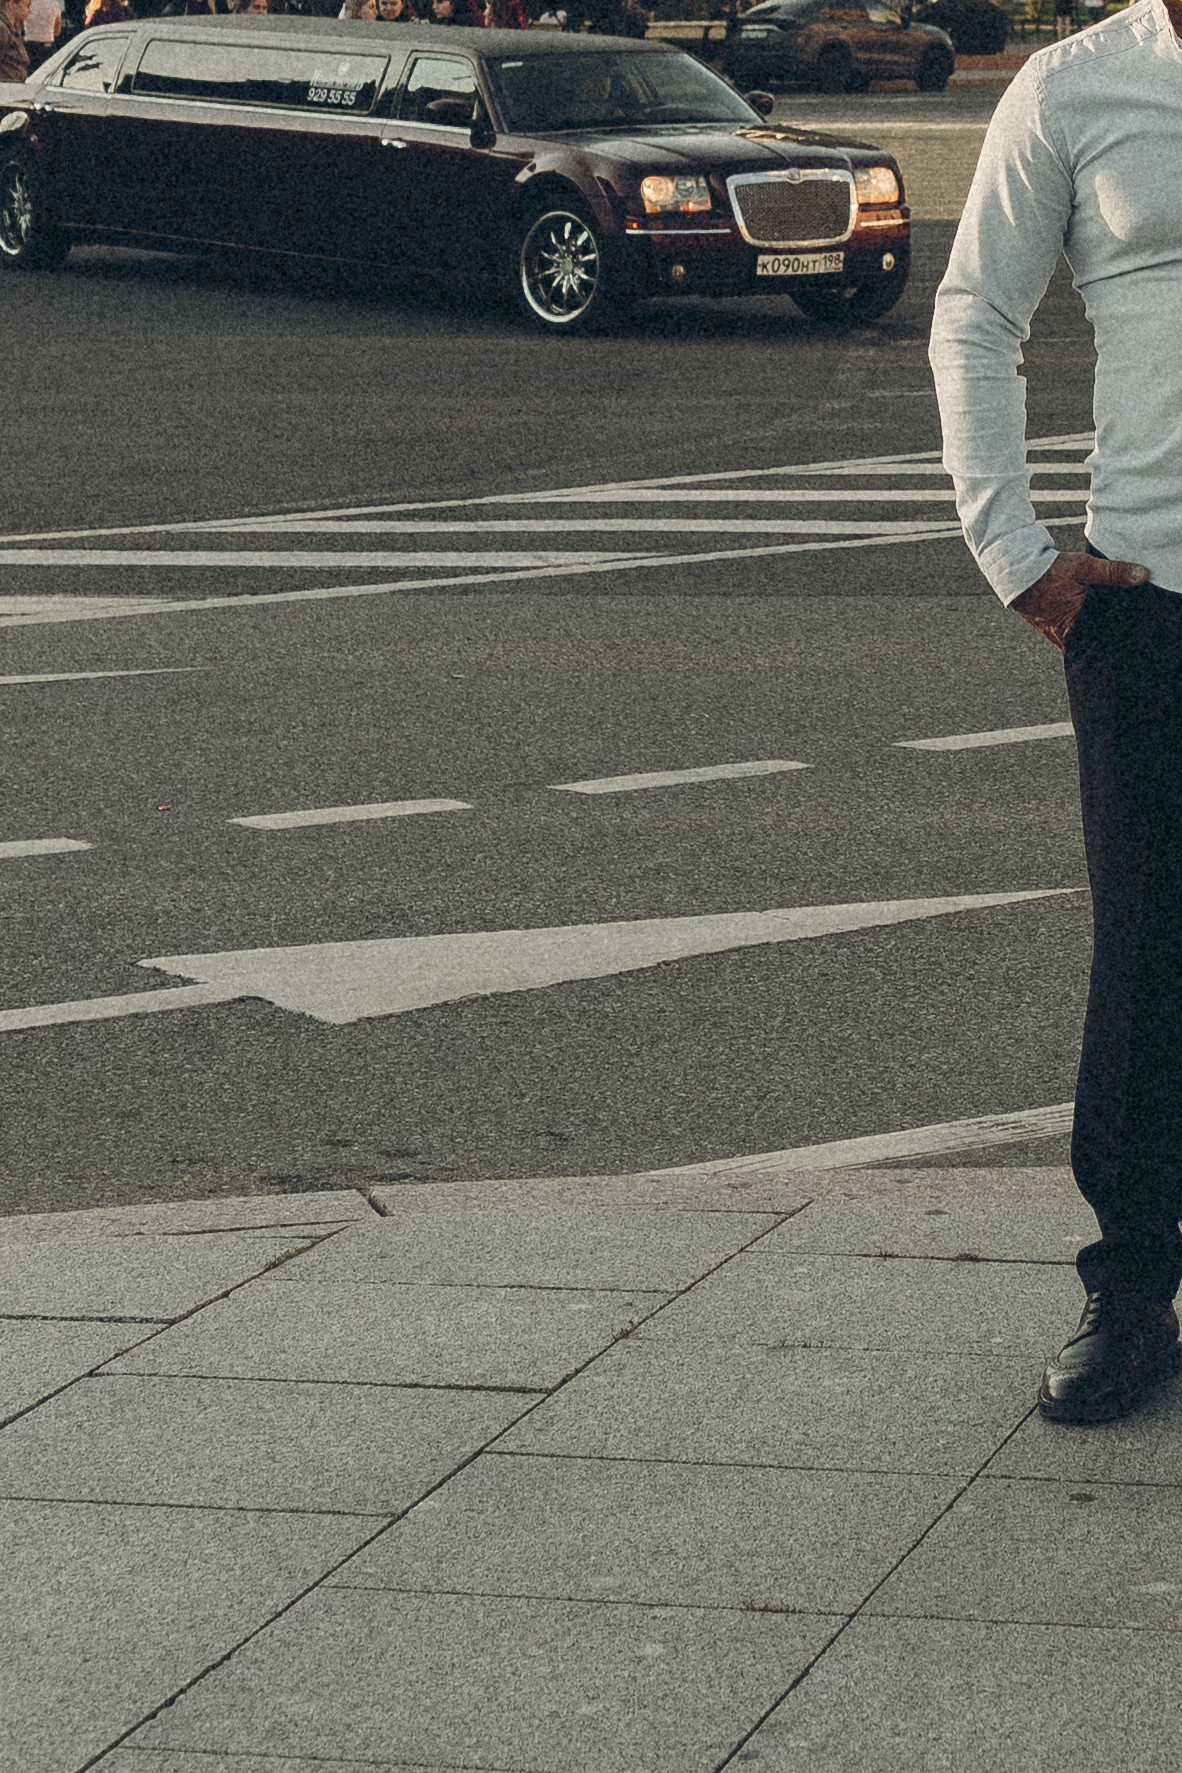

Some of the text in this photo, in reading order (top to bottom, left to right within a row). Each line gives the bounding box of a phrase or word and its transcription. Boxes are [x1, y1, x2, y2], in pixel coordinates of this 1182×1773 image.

[307, 88, 356, 105] 929 55 55
[822, 253, 841, 267] 198
